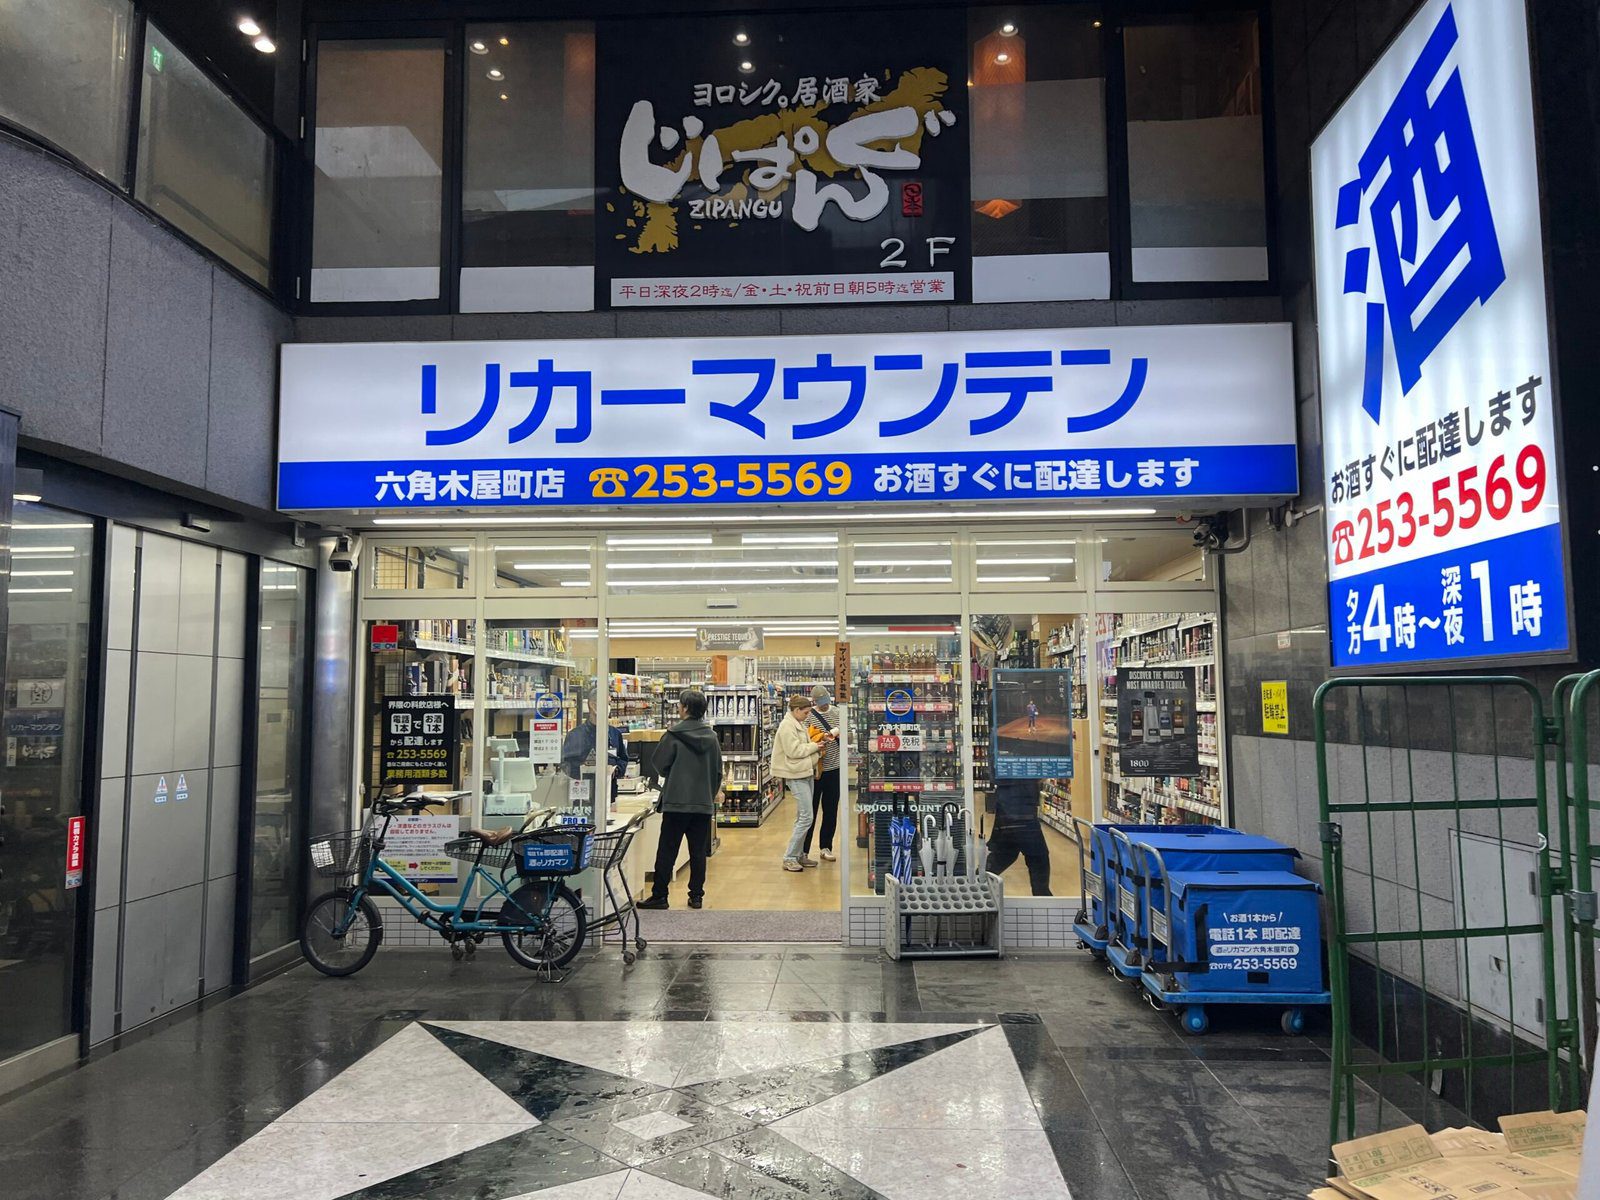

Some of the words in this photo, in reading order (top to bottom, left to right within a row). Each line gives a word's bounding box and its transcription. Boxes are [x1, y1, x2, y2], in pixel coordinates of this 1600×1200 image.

[693, 74, 882, 108] ヨロシク。居酒家
[688, 199, 783, 219] ZIPANGU
[1335, 2, 1506, 427] 酒
[421, 349, 1148, 446] リカーマウンテン
[1331, 375, 1543, 504] お酒すぐに配達します
[375, 467, 565, 501] 六角木屋町店
[632, 462, 852, 499] 253-5569
[873, 457, 1200, 493] お酒すぐに配達します
[1357, 443, 1547, 561] 253-5569
[709, 632, 731, 641] PRESTIGE
[1128, 671, 1152, 680] DISCOVER
[1153, 671, 1162, 679] THE
[1126, 681, 1140, 689] MOST
[413, 720, 422, 729] で
[902, 737, 920, 746] 免税
[397, 749, 448, 759] 253-5569
[854, 803, 894, 813] LIQUOR
[1209, 927, 1258, 941] 電話1本
[1261, 926, 1301, 941] 即配達
[1233, 957, 1298, 970] 253-5569
